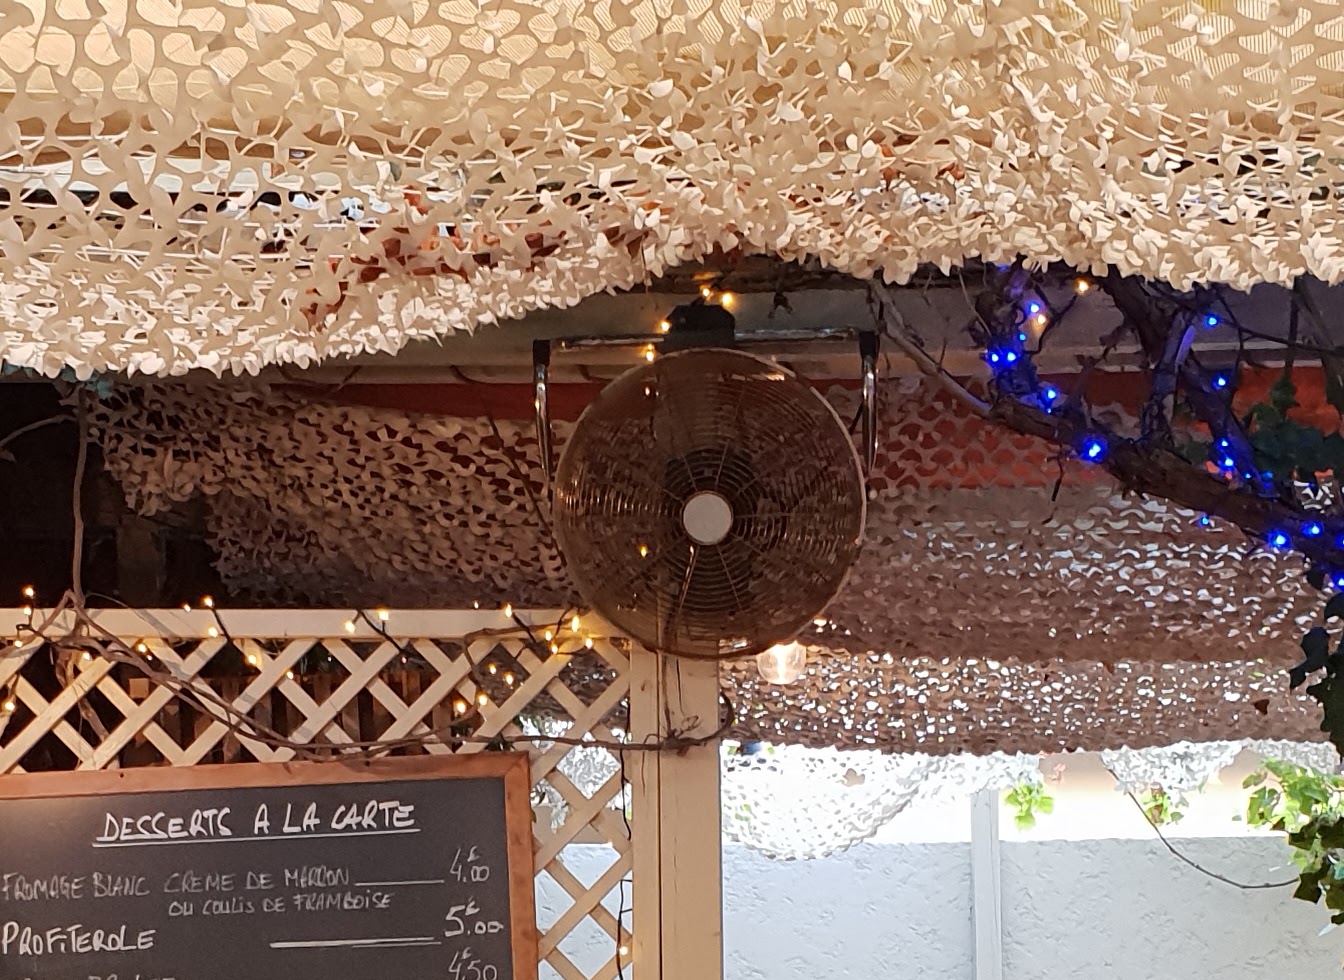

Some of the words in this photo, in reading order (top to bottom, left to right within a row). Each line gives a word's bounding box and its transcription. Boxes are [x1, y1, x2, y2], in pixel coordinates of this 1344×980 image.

[96, 807, 232, 840] DESSERTS
[253, 803, 271, 834] A
[282, 802, 320, 833] LA
[331, 800, 415, 830] CARTE
[2, 872, 87, 900] FROMAGE
[92, 871, 150, 898] BLANC
[163, 870, 236, 893] CREME
[246, 871, 274, 890] DE
[284, 866, 350, 888] MARRON
[262, 897, 286, 912] DE
